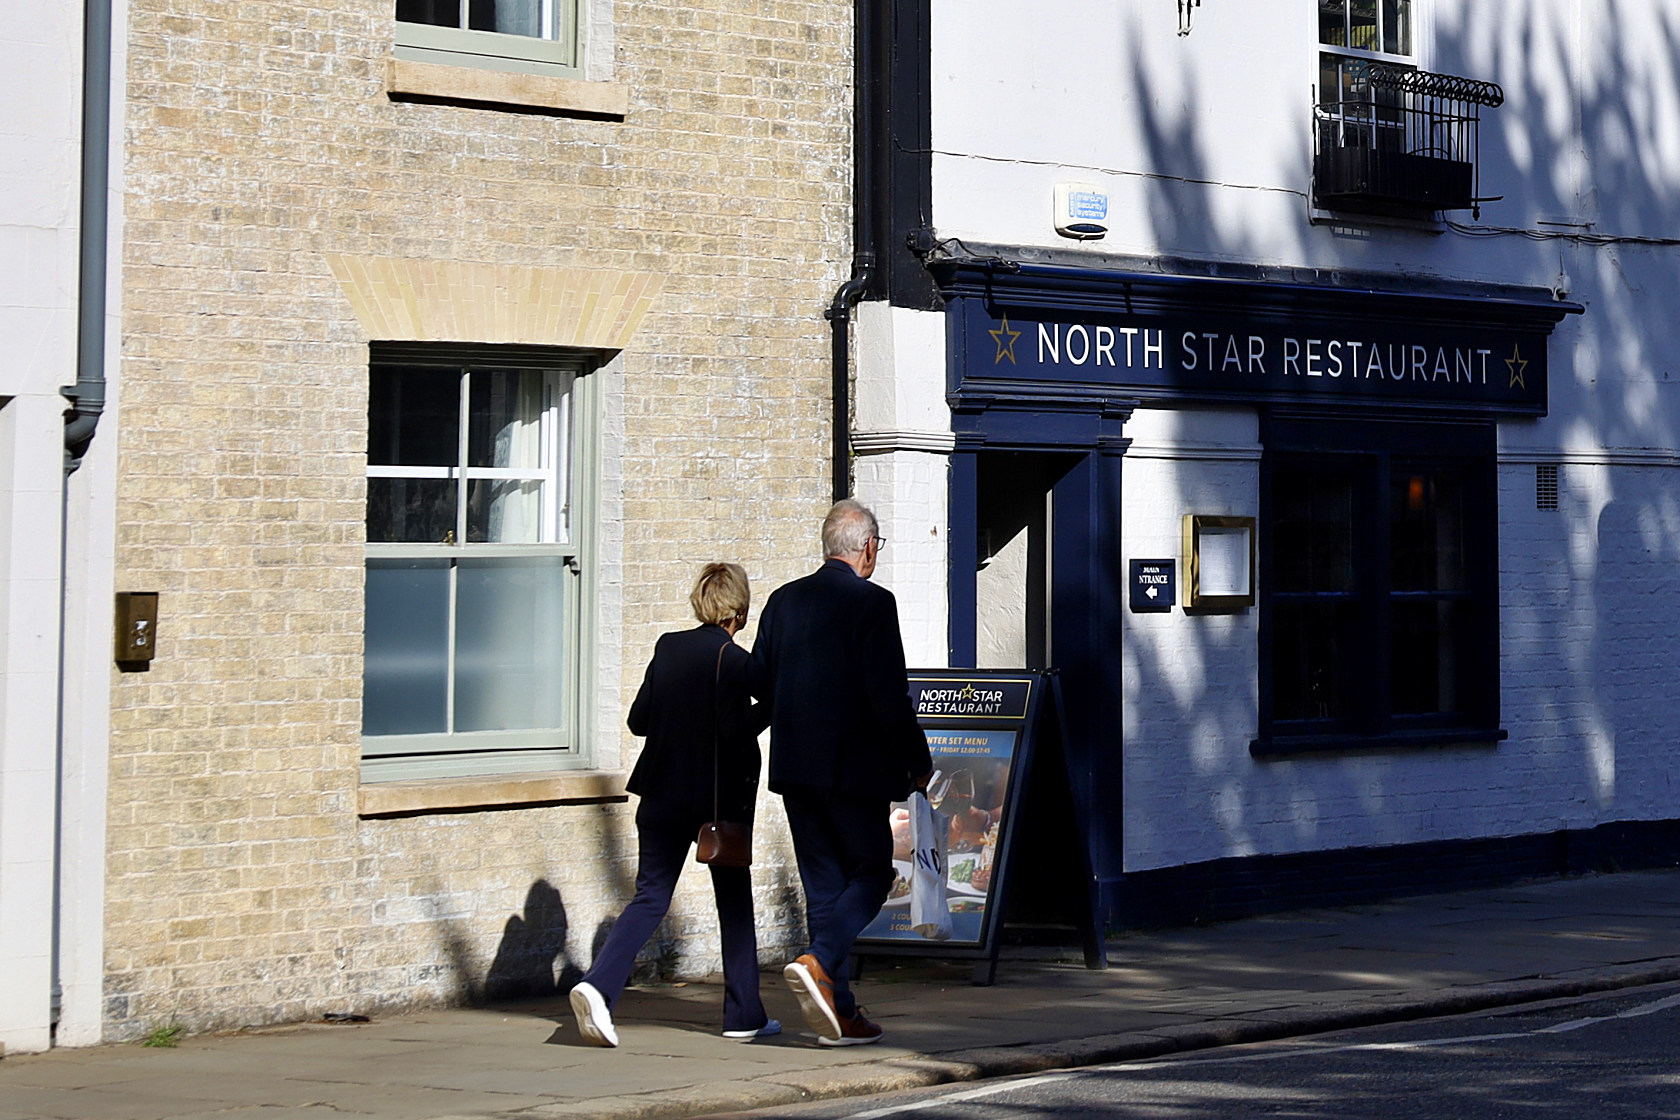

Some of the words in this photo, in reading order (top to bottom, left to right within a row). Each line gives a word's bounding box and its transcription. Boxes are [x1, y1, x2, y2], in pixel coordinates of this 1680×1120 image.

[1037, 322, 1163, 369] NORTH
[1181, 331, 1266, 374] STAR
[1283, 337, 1491, 384] RESTAURANT
[920, 689, 962, 701] NORTH
[972, 690, 1003, 702] STAR
[918, 702, 1002, 713] RESTAURANT
[926, 736, 948, 745] NTER
[948, 736, 963, 745] SET
[964, 737, 989, 746] MENU
